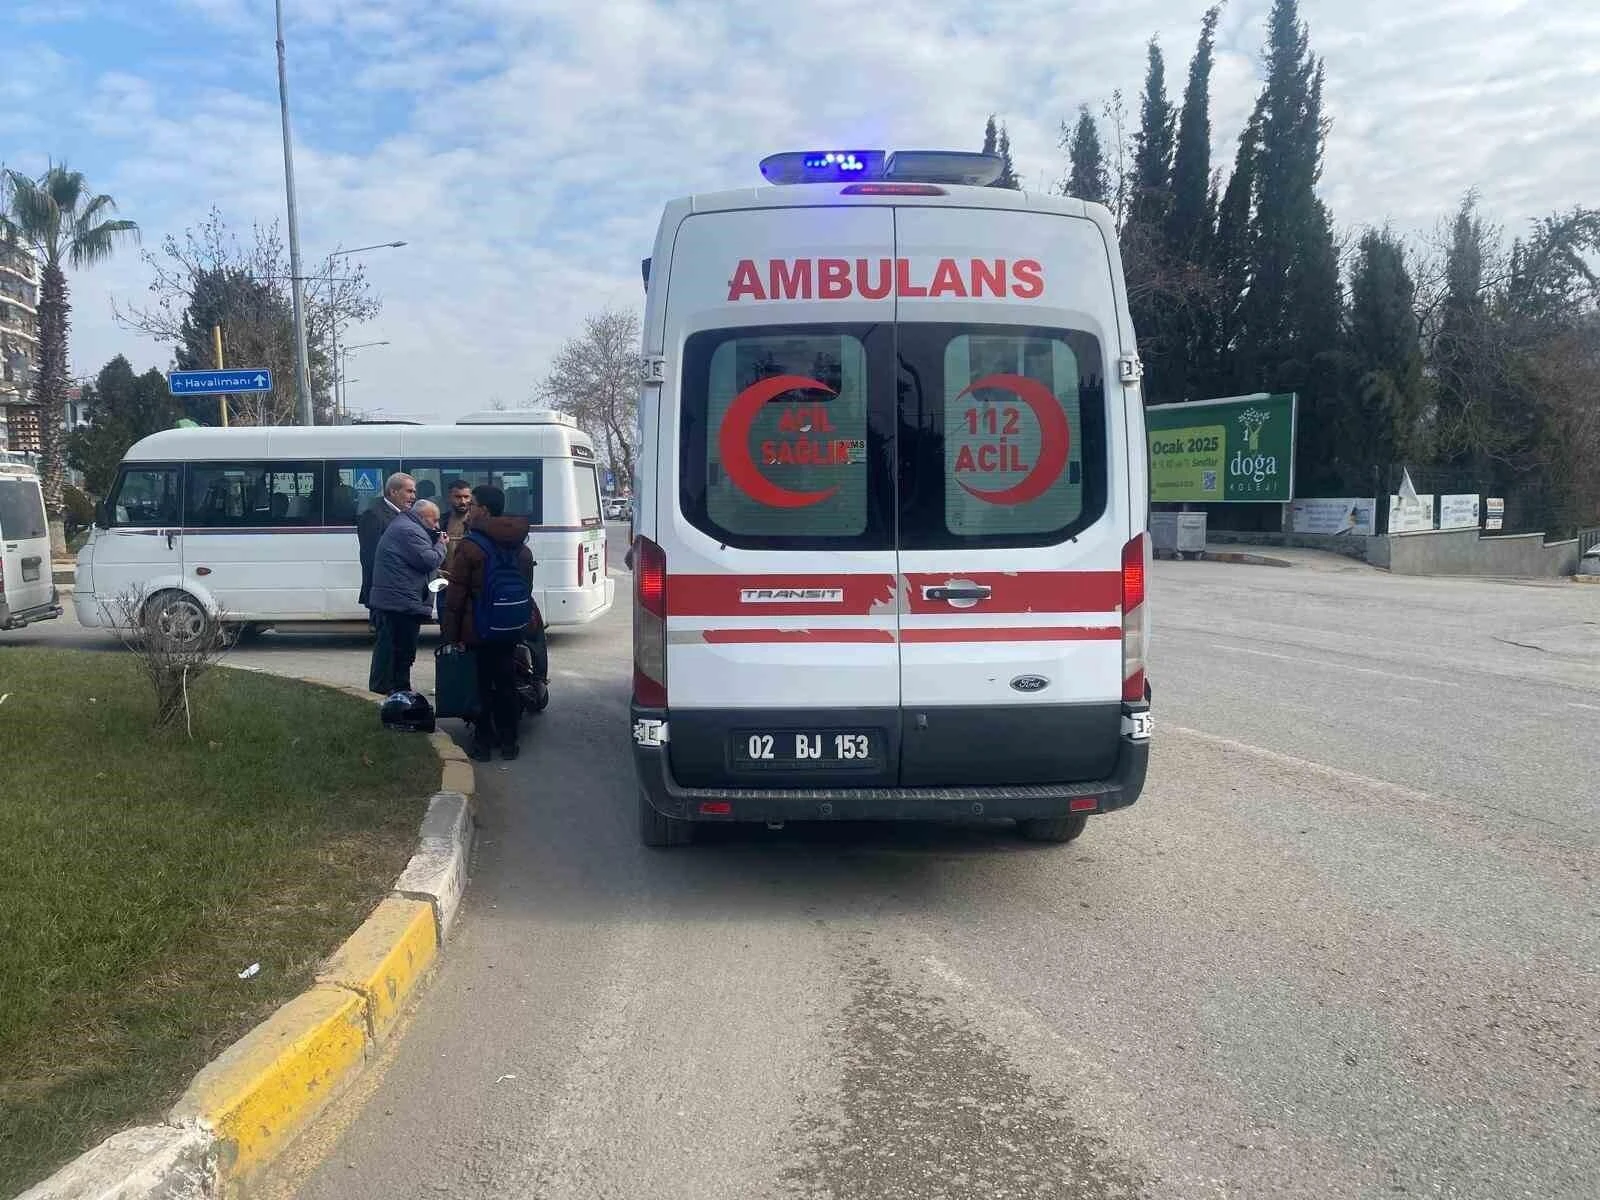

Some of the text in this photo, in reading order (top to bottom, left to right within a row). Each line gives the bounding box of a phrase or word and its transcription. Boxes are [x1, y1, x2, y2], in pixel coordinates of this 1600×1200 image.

[728, 258, 1046, 300] AMBULANS
[964, 407, 1020, 435] 112
[955, 436, 1029, 472] ACİL
[1152, 436, 1219, 455] Ocak 2025
[1230, 450, 1277, 482] doğa
[741, 589, 842, 599] TRANSIT
[749, 735, 869, 759] 02 BJ 153
